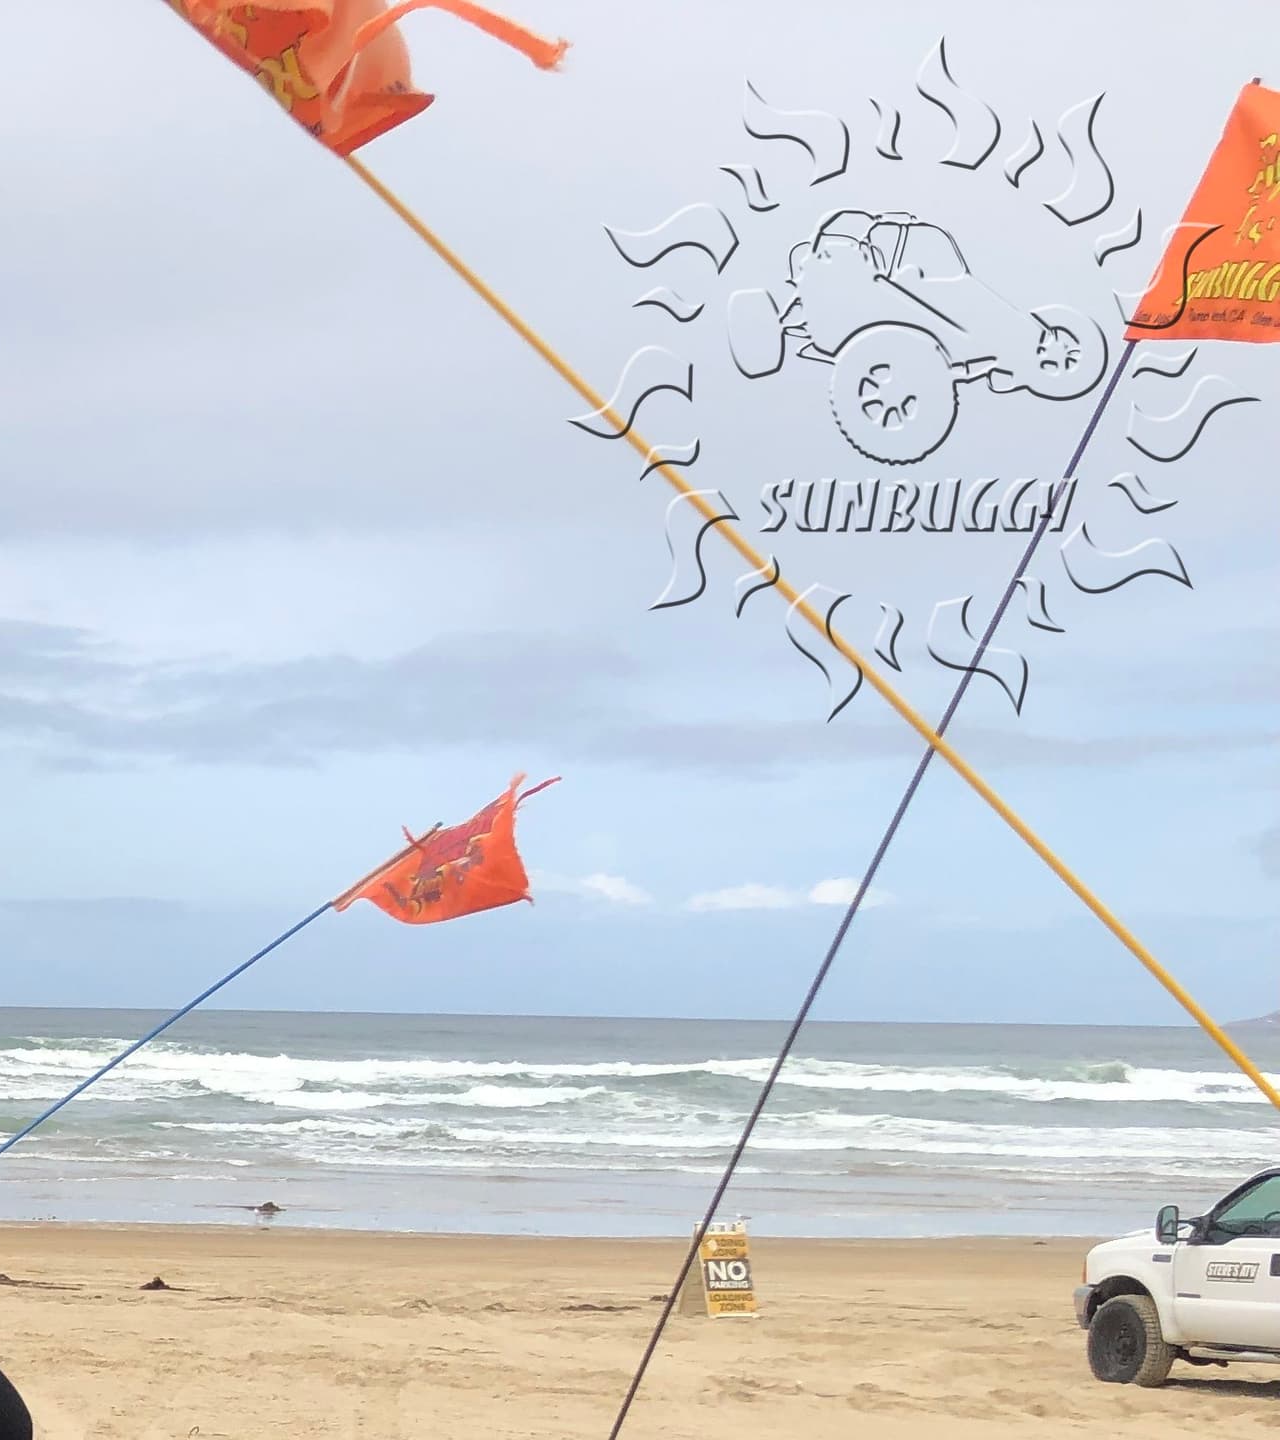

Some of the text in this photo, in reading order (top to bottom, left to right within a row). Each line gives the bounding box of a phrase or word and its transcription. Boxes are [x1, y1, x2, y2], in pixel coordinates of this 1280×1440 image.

[708, 1261, 746, 1281] NO
[709, 1280, 749, 1289] PARKING
[709, 1293, 753, 1302] LOADING
[720, 1302, 746, 1311] ZONE
